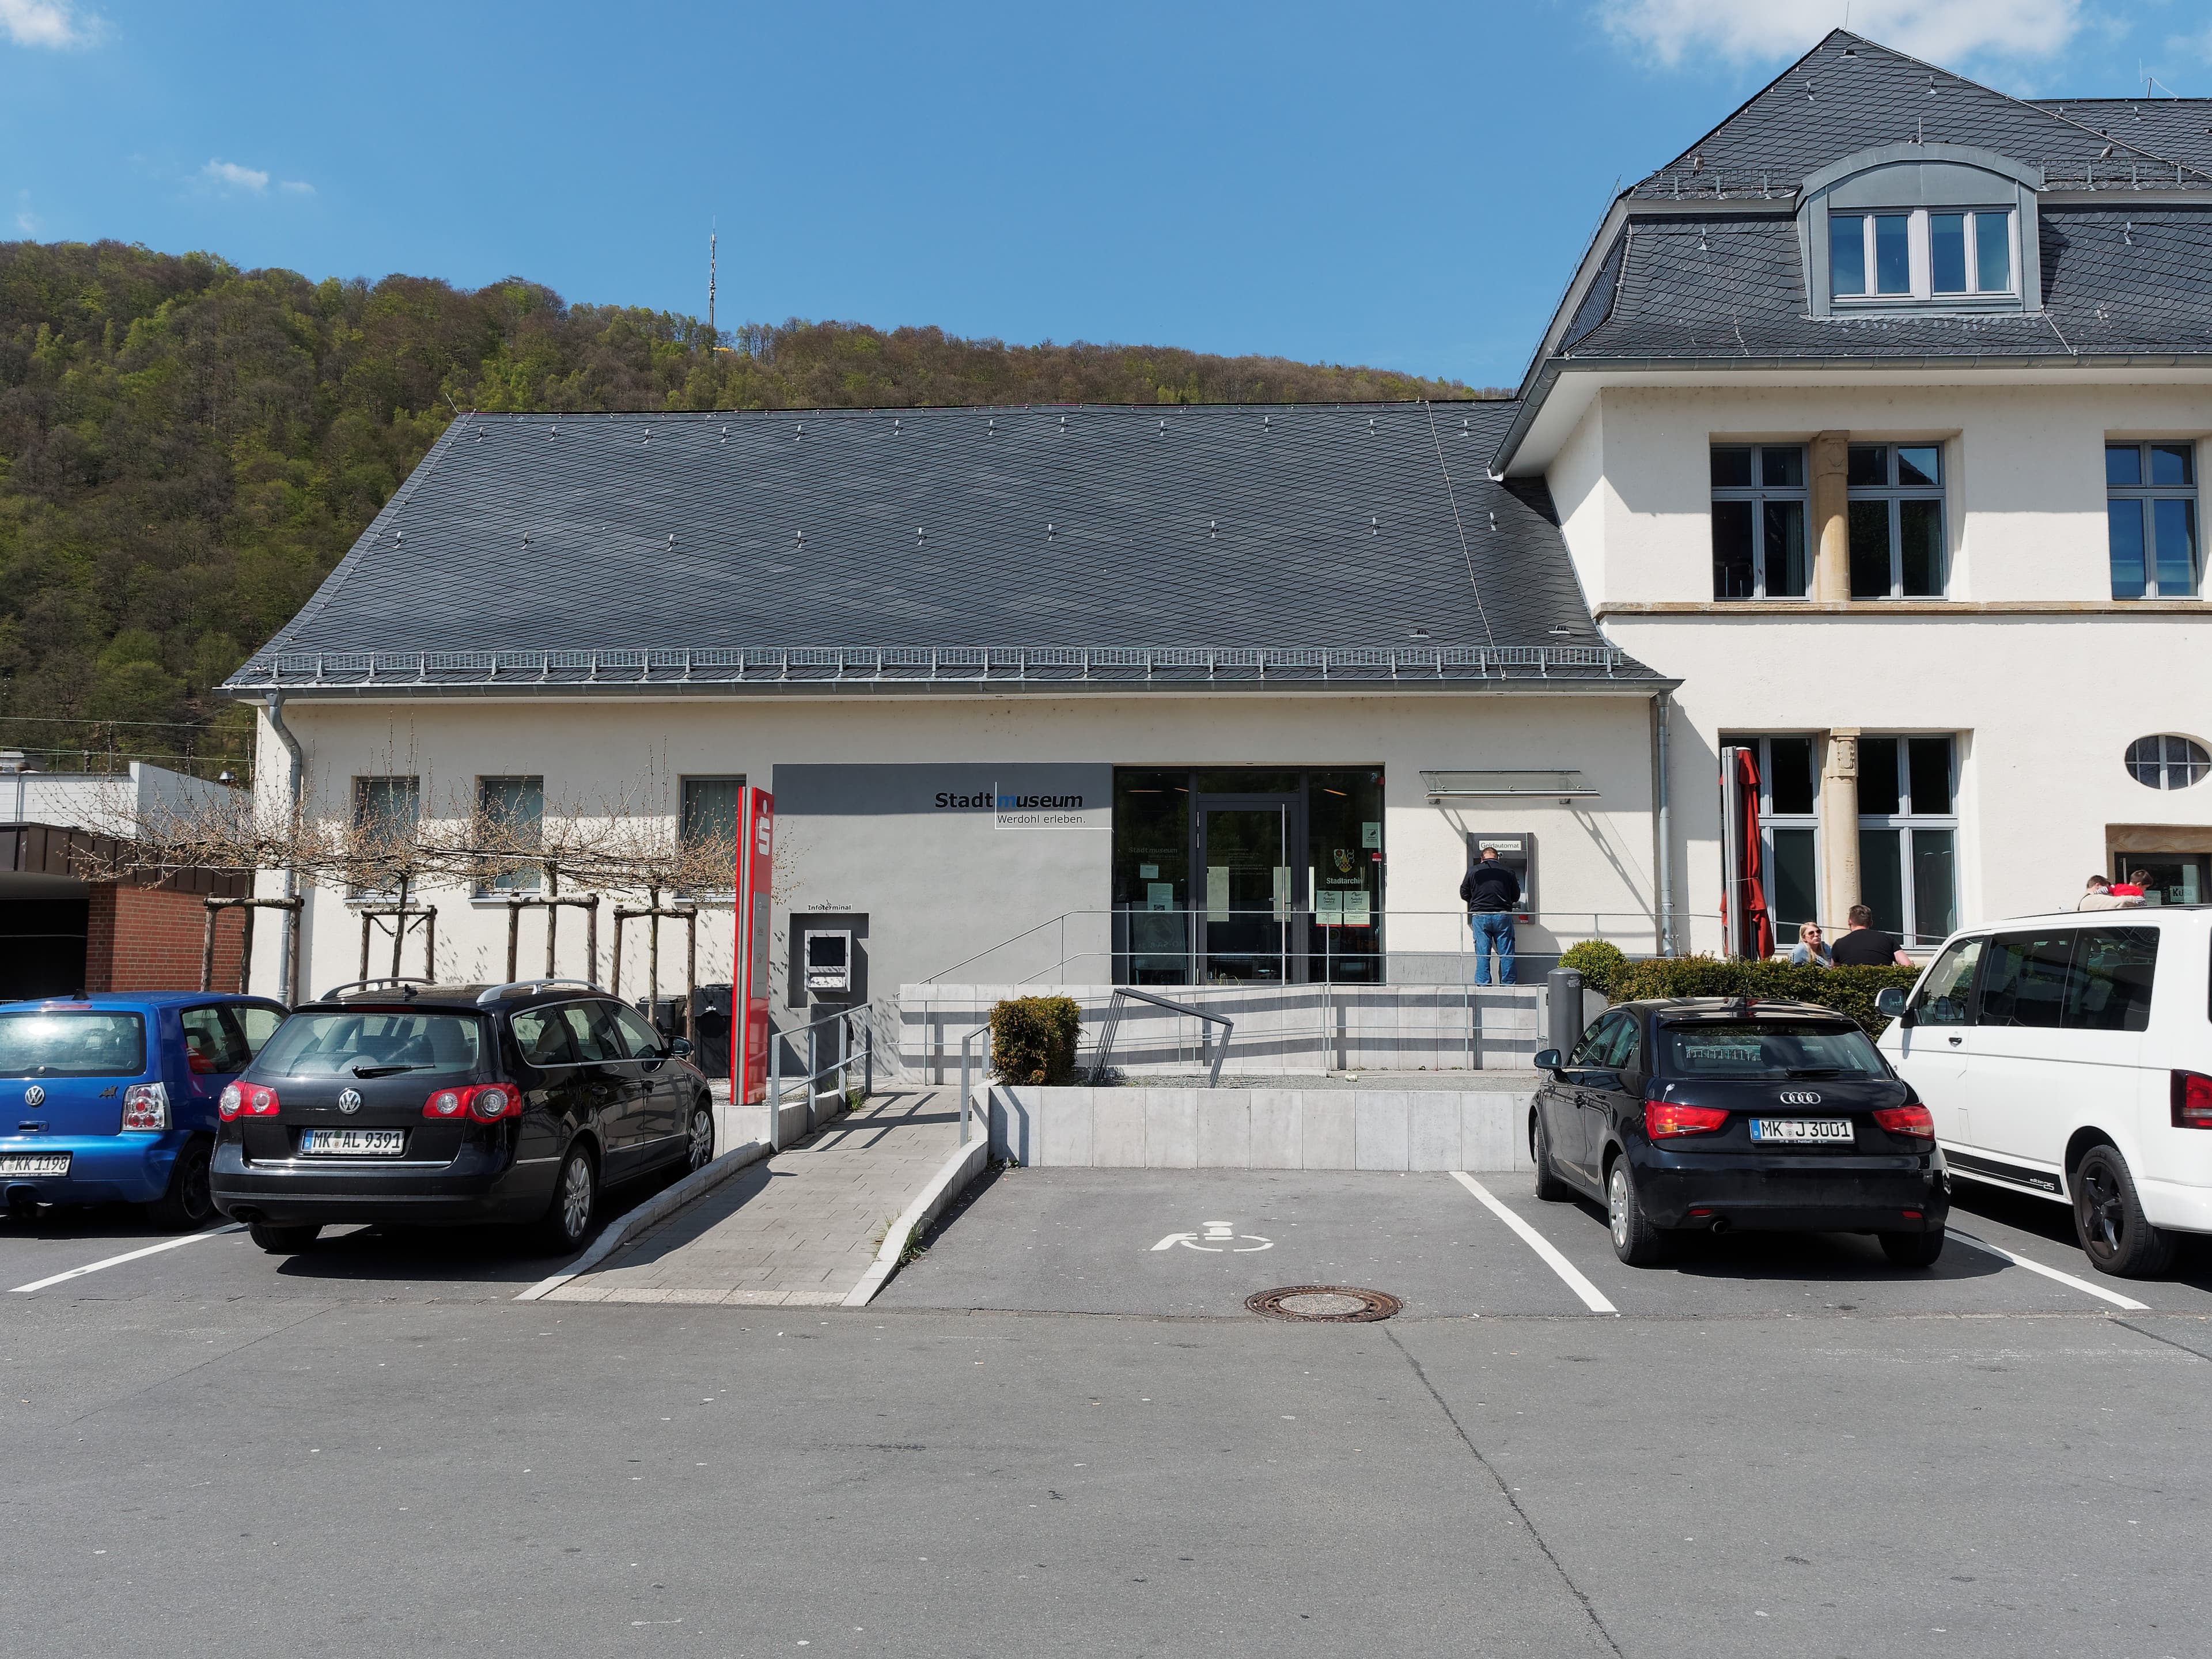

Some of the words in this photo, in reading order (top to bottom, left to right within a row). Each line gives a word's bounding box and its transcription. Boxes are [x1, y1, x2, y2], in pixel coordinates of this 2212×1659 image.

[997, 814, 1040, 824] Werdohl
[1043, 814, 1086, 824] erleben.
[1761, 1121, 1783, 1137] MK
[1796, 1122, 1805, 1137] J
[1810, 1122, 1850, 1137] 3001
[313, 1132, 334, 1147] MK
[342, 1132, 360, 1148] AL
[365, 1132, 400, 1149] 9391
[15, 1156, 33, 1171] KK
[34, 1156, 68, 1171] 1198
